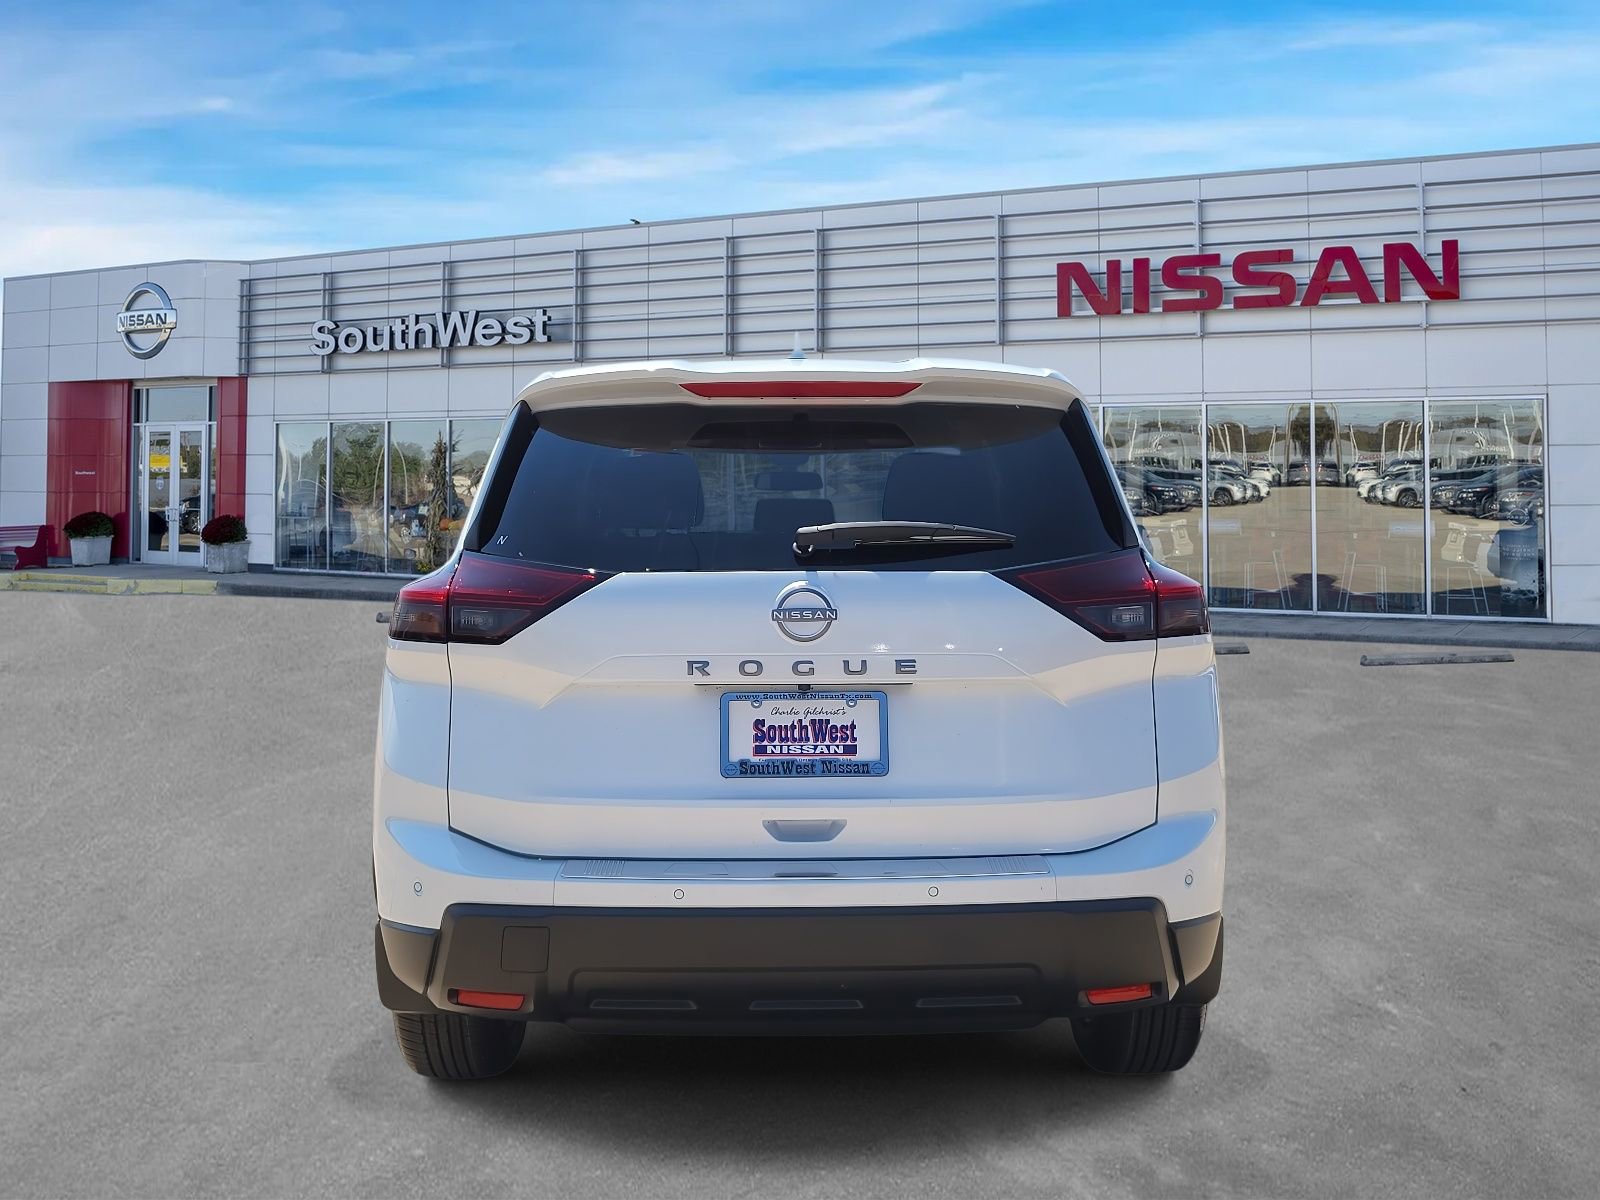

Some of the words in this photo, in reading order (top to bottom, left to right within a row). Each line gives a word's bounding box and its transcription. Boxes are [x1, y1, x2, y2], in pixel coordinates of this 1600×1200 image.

[1056, 239, 1461, 318] NISSAN
[119, 312, 167, 328] NISSAN
[308, 308, 552, 356] SouthWest
[773, 610, 836, 620] NISSAN
[686, 659, 918, 677] ROGUE
[770, 706, 801, 716] Charlie
[803, 706, 847, 719] Gilchrist's
[752, 718, 858, 744] SouthWest
[766, 745, 844, 754] NISSAN
[739, 760, 817, 775] SouthWest
[821, 760, 871, 774] Nissan
